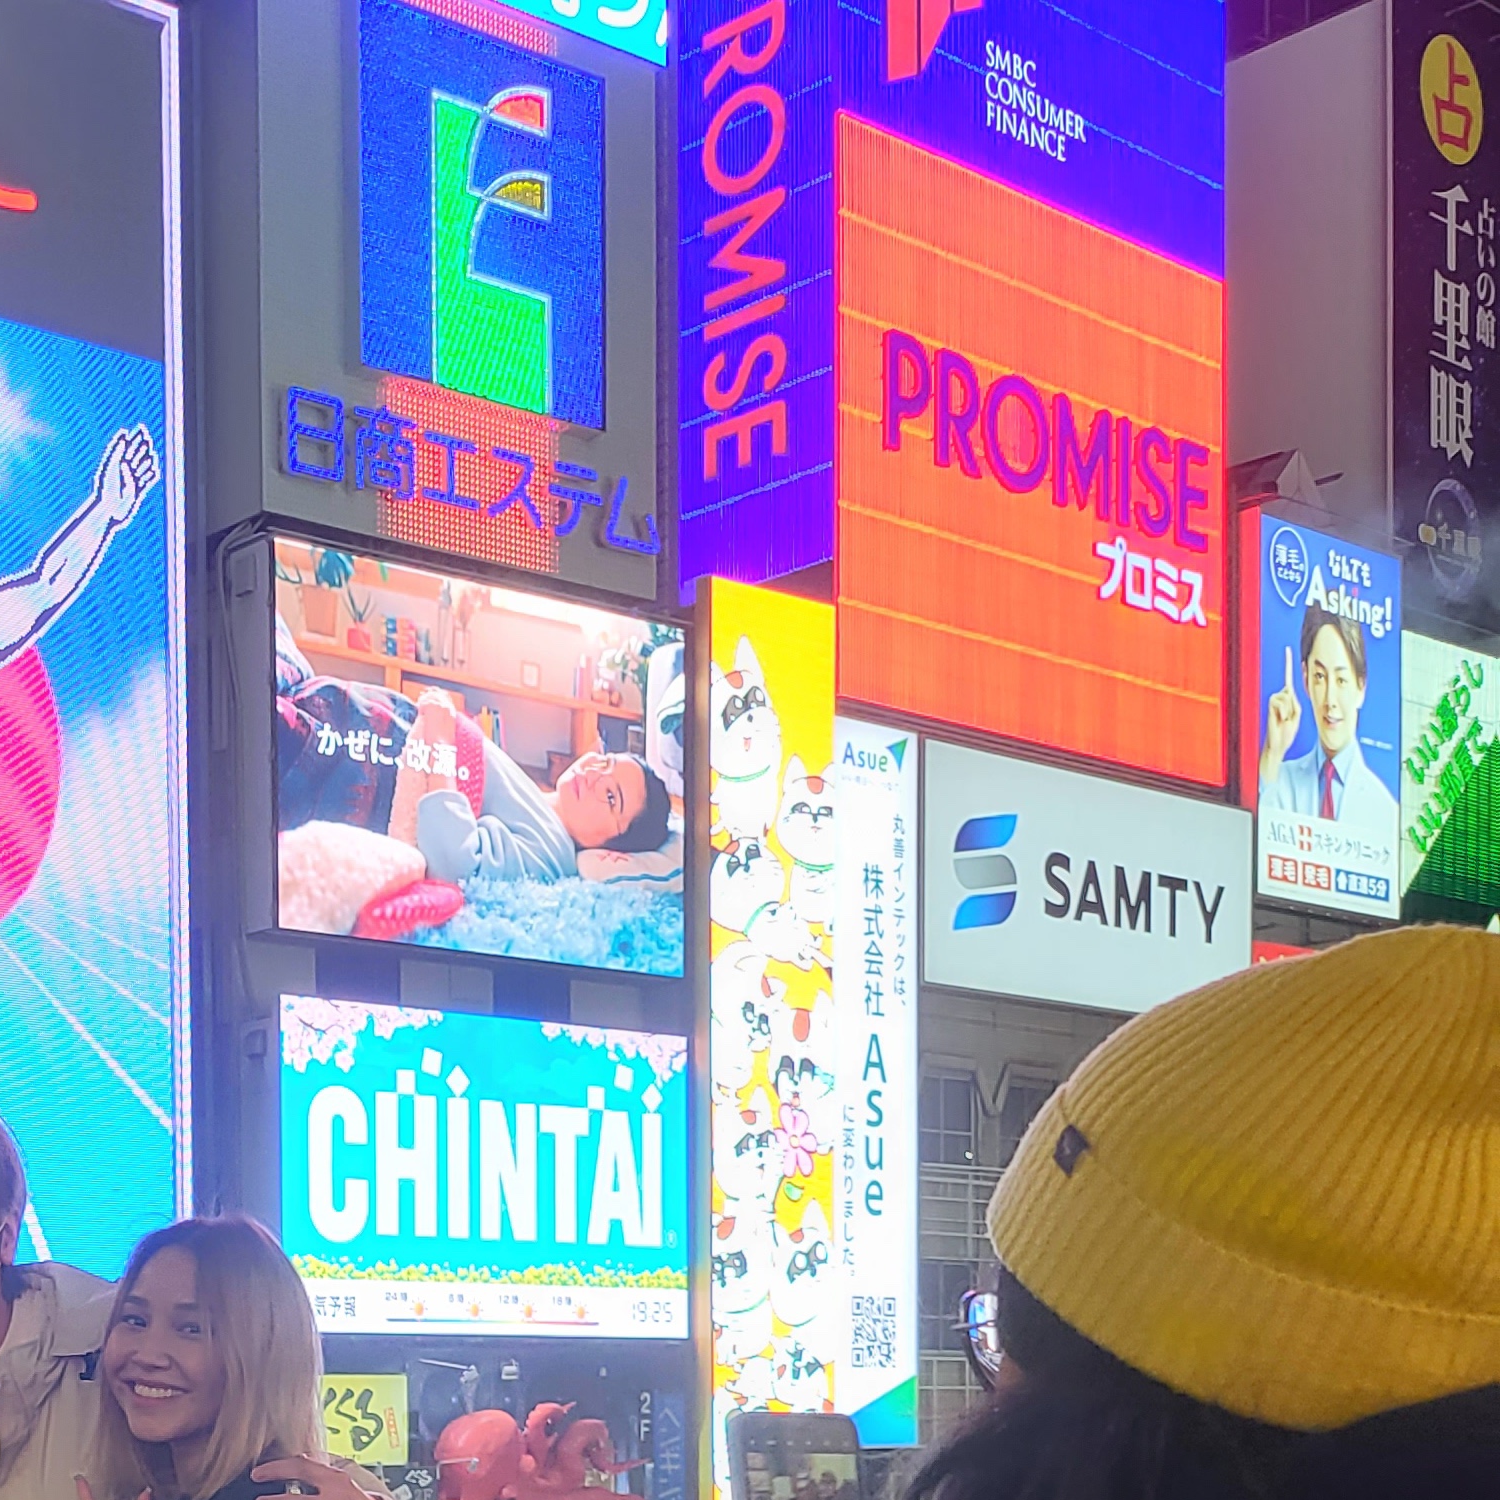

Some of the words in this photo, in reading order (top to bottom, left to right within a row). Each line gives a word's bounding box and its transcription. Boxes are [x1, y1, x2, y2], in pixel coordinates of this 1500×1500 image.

[984, 71, 1087, 143] CONSUMER
[985, 40, 1037, 88] SMBC
[1432, 41, 1472, 153] 占
[985, 100, 1067, 162] FINANCE
[702, 0, 789, 481] ROMISE
[1428, 184, 1475, 469] 千里眼
[287, 386, 661, 556] 日商エステム
[882, 329, 1209, 554] PROMISE
[1094, 536, 1208, 628] プロミス
[1304, 563, 1393, 639] Asking!
[316, 722, 470, 781] かぜに、改源。
[842, 741, 888, 773] Asue
[862, 861, 886, 1018] 株式会社
[1043, 851, 1226, 944] SAMTY
[306, 1050, 664, 1249] CHINTAI
[862, 1033, 888, 1217] Asue
